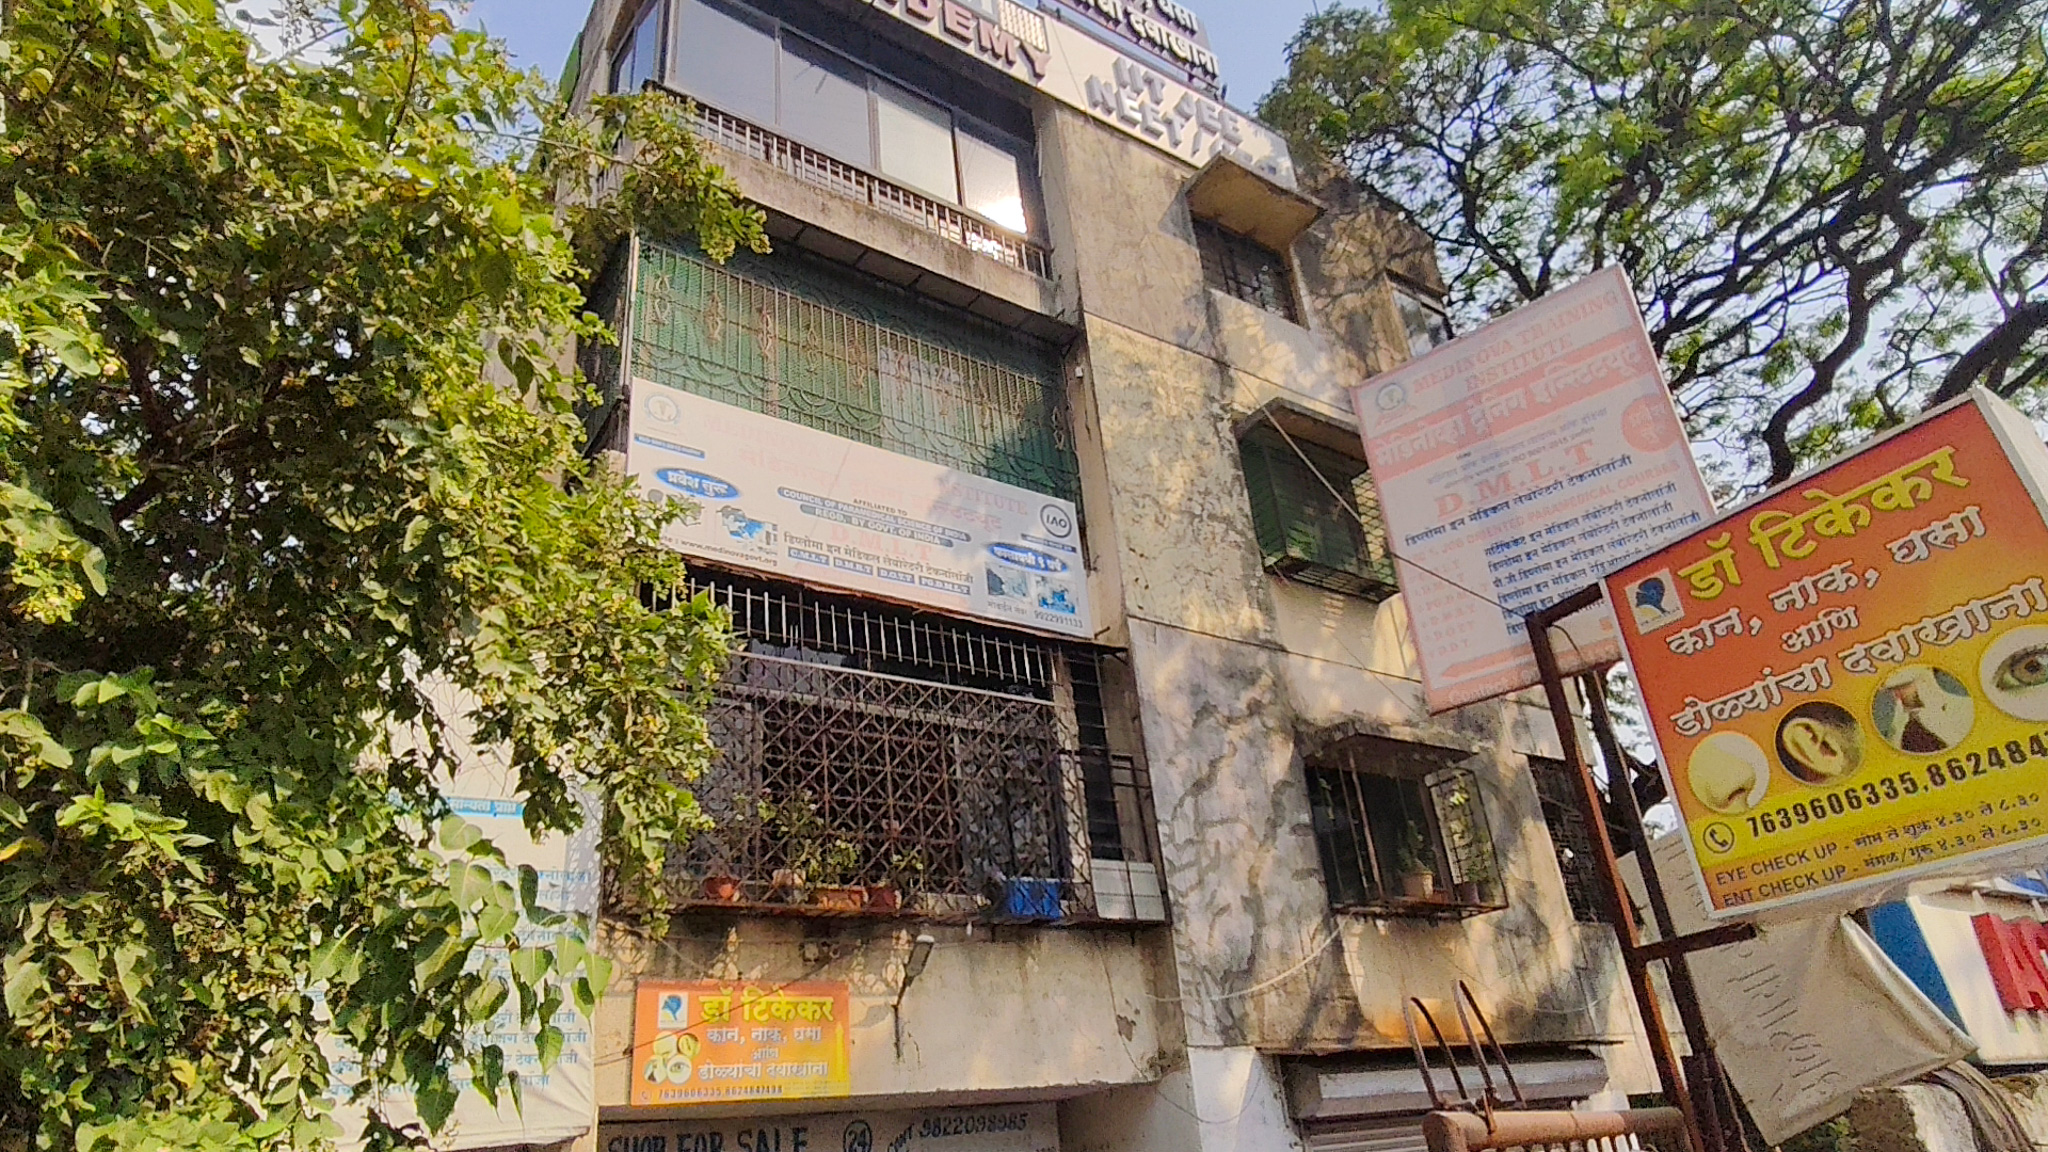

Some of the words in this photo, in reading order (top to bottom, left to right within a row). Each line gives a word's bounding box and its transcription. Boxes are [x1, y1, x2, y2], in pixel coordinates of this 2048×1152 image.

[1084, 74, 1185, 148] NEET
[1173, 91, 1243, 146] JEE
[783, 488, 823, 505] COUNCIL
[836, 502, 896, 524] PARAMEDICAL
[943, 528, 966, 541] INDIA
[852, 497, 895, 514] AFFILIATED
[1405, 524, 1446, 547] डिप्लोमा
[1448, 518, 1466, 531] इन
[1467, 499, 1510, 522] मेडिकल
[1677, 533, 1743, 600] डॉ
[1749, 445, 1969, 569] टिकेकर
[850, 516, 865, 527] BY
[913, 530, 941, 545] INDIA
[1528, 530, 1543, 542] इन
[1543, 515, 1579, 535] मेडिकल
[843, 546, 880, 563] मेडिकल
[1488, 553, 1523, 572] डिप्लोमा
[1524, 549, 1539, 560] इन
[1539, 534, 1576, 554] मेडिकल
[1554, 557, 1569, 568] इन
[1569, 542, 1605, 562] मेडिकल
[1497, 583, 1533, 603] डिप्लोमा
[1534, 581, 1550, 592] इन
[1550, 566, 1587, 587] मेडिकल
[1666, 607, 1763, 656] कान,
[1769, 560, 1881, 613] नाक,
[1886, 506, 1987, 563] घसा
[1780, 606, 1860, 653] आणि
[1671, 656, 1831, 736] डोळ्यांचा
[1838, 577, 2047, 675] दवाखाना
[1747, 731, 2048, 838] 7639606335,862484
[1715, 866, 1748, 886] EYE
[1751, 850, 1812, 876] CHECK
[1814, 842, 1838, 861] UP
[1722, 887, 1754, 907] ENT
[1759, 869, 1820, 897] CHECK
[1822, 863, 1847, 882] UP
[699, 986, 733, 1024] डॉ
[740, 985, 834, 1022] टिकेकर
[706, 1027, 745, 1044] कान,
